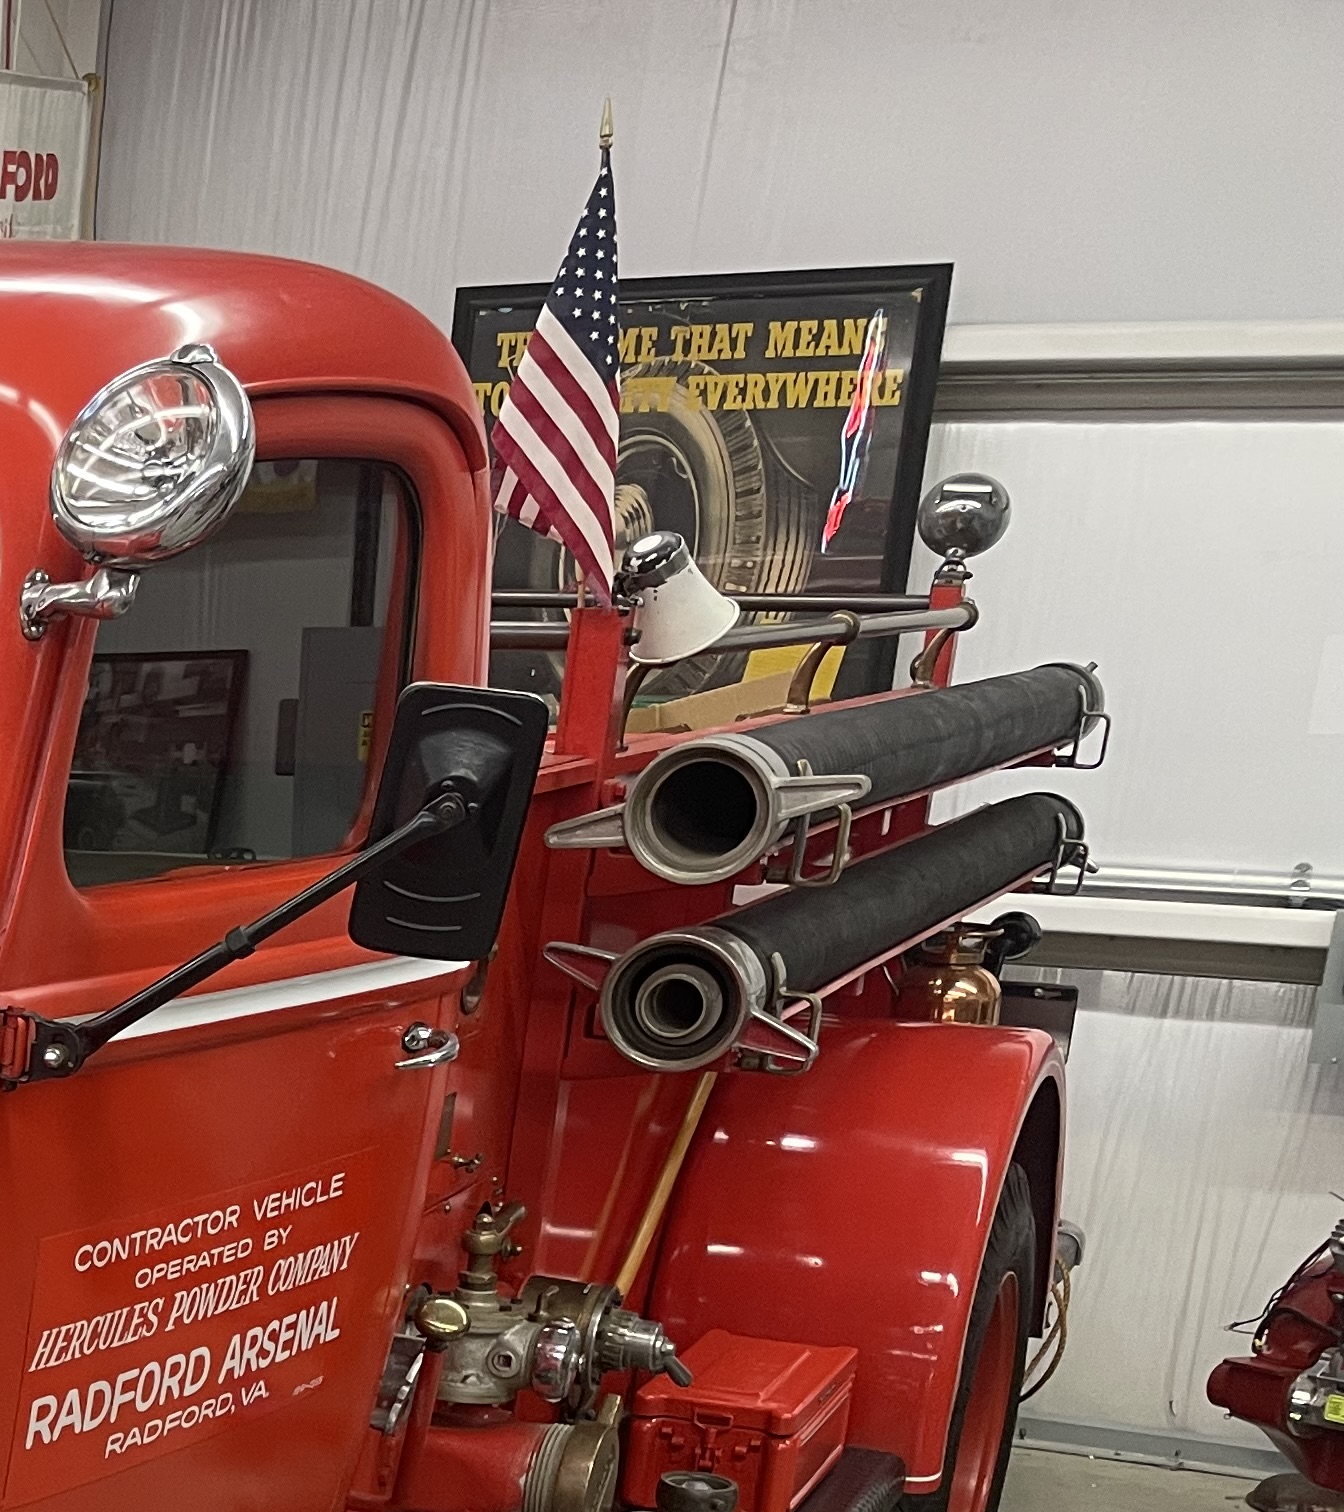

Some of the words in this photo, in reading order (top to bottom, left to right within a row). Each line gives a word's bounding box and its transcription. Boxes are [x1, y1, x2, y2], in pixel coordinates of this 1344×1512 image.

[670, 321, 754, 361] THAT
[688, 368, 904, 411] EVERYWHERE
[73, 1204, 241, 1272] CONTRACTOR
[252, 1172, 346, 1222] VEHICLE
[134, 1237, 253, 1289] OPERATED
[263, 1224, 293, 1251] BY
[27, 1296, 165, 1374] HERCULES
[164, 1264, 264, 1333] POWDER
[266, 1231, 361, 1298] COMPANY
[24, 1346, 211, 1451] RADFORD
[217, 1296, 341, 1385] ARSENAL
[104, 1393, 236, 1460] RADFORD,
